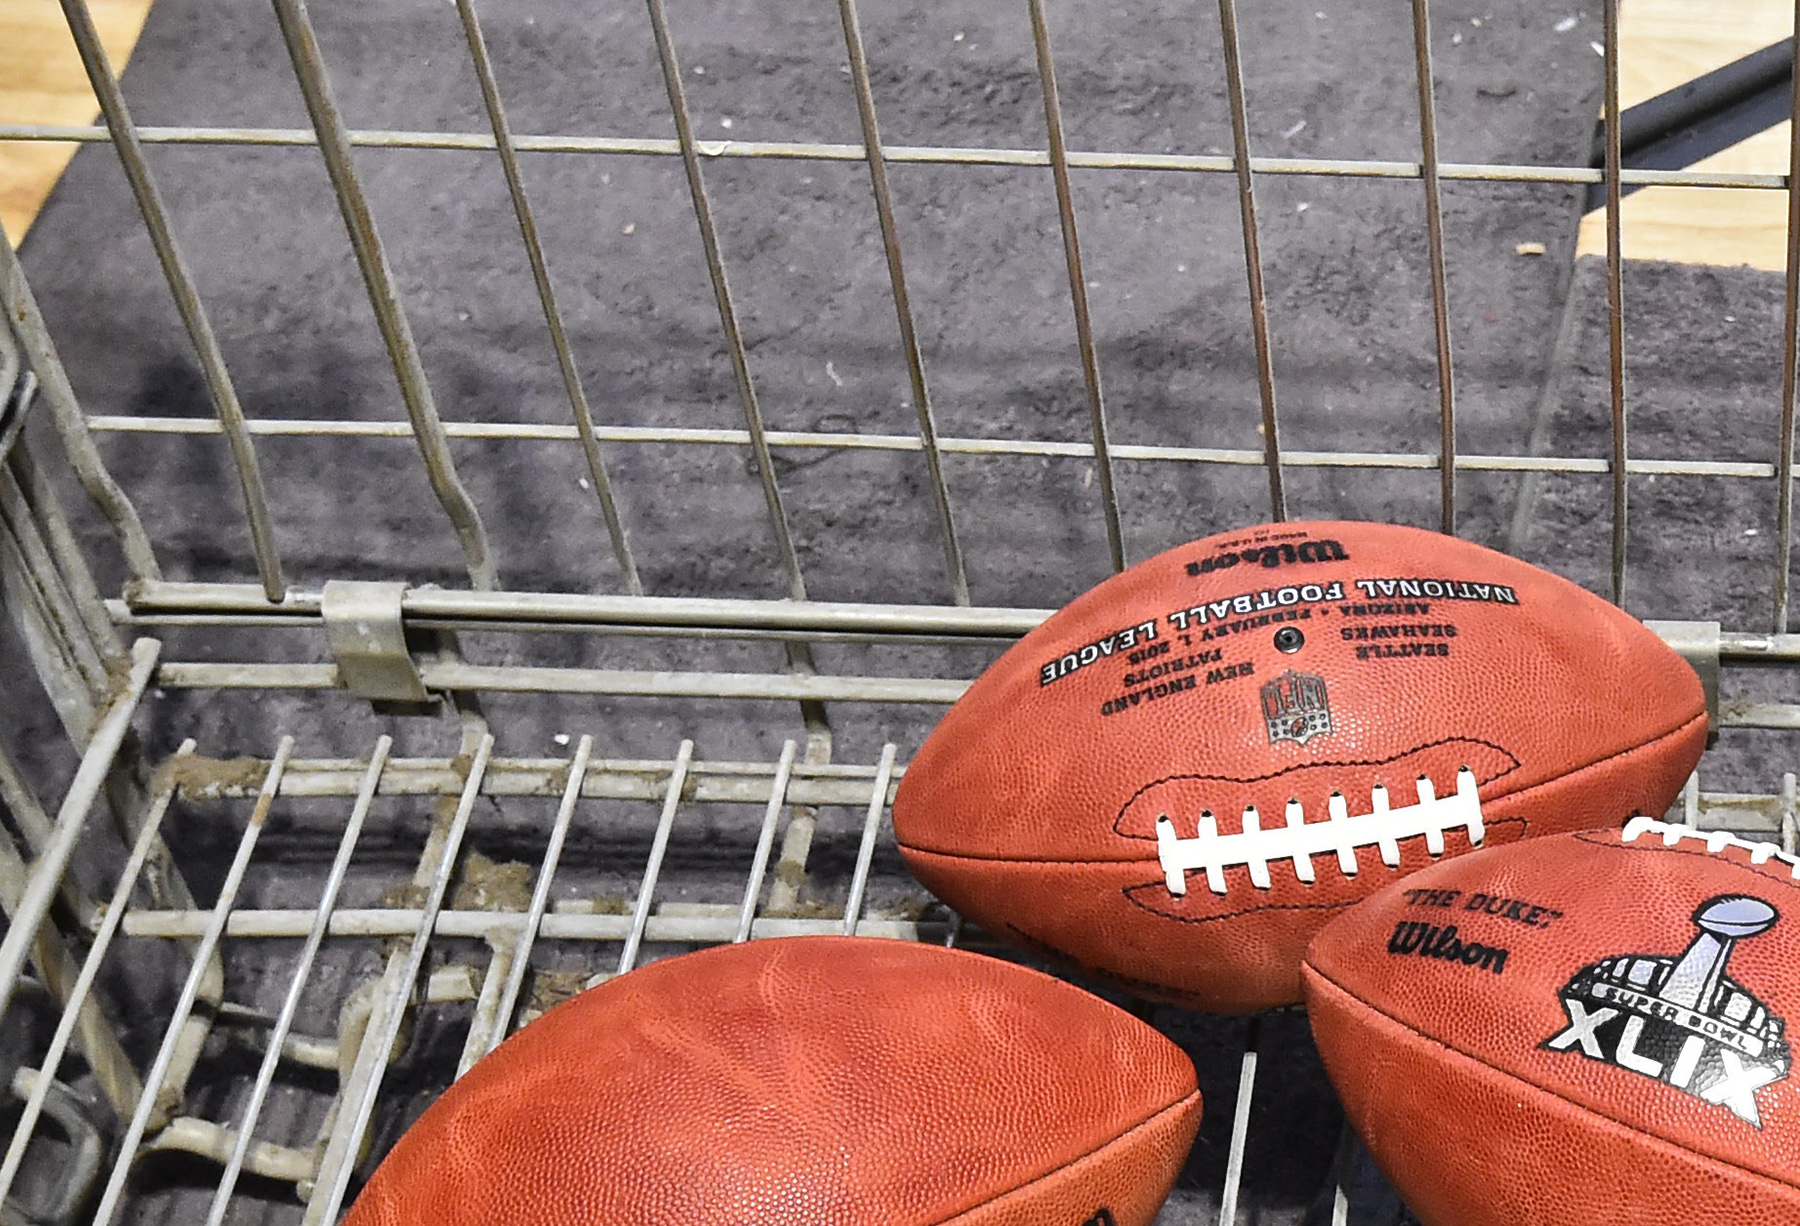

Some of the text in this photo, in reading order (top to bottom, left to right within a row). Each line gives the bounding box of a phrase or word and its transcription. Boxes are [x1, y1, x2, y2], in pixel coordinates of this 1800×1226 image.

[1185, 539, 1350, 577] Wilson
[1201, 608, 1312, 642] FEBRUARY
[1340, 603, 1430, 617] ARIZONA
[1040, 578, 1519, 687] NATIONAL FOOTBALL LEAGUE
[1127, 640, 1170, 665] 2015
[1341, 624, 1459, 642] SEAHAWKS
[1356, 643, 1449, 661] SEATTLE
[1124, 647, 1224, 688] PATRIOTS
[1101, 661, 1256, 717] NEW ENGLAND
[1262, 674, 1330, 721] NFL
[1387, 920, 1509, 975] Wilson
[1604, 986, 1750, 1052] SUPER BOWL
[1545, 997, 1783, 1131] XLIX
